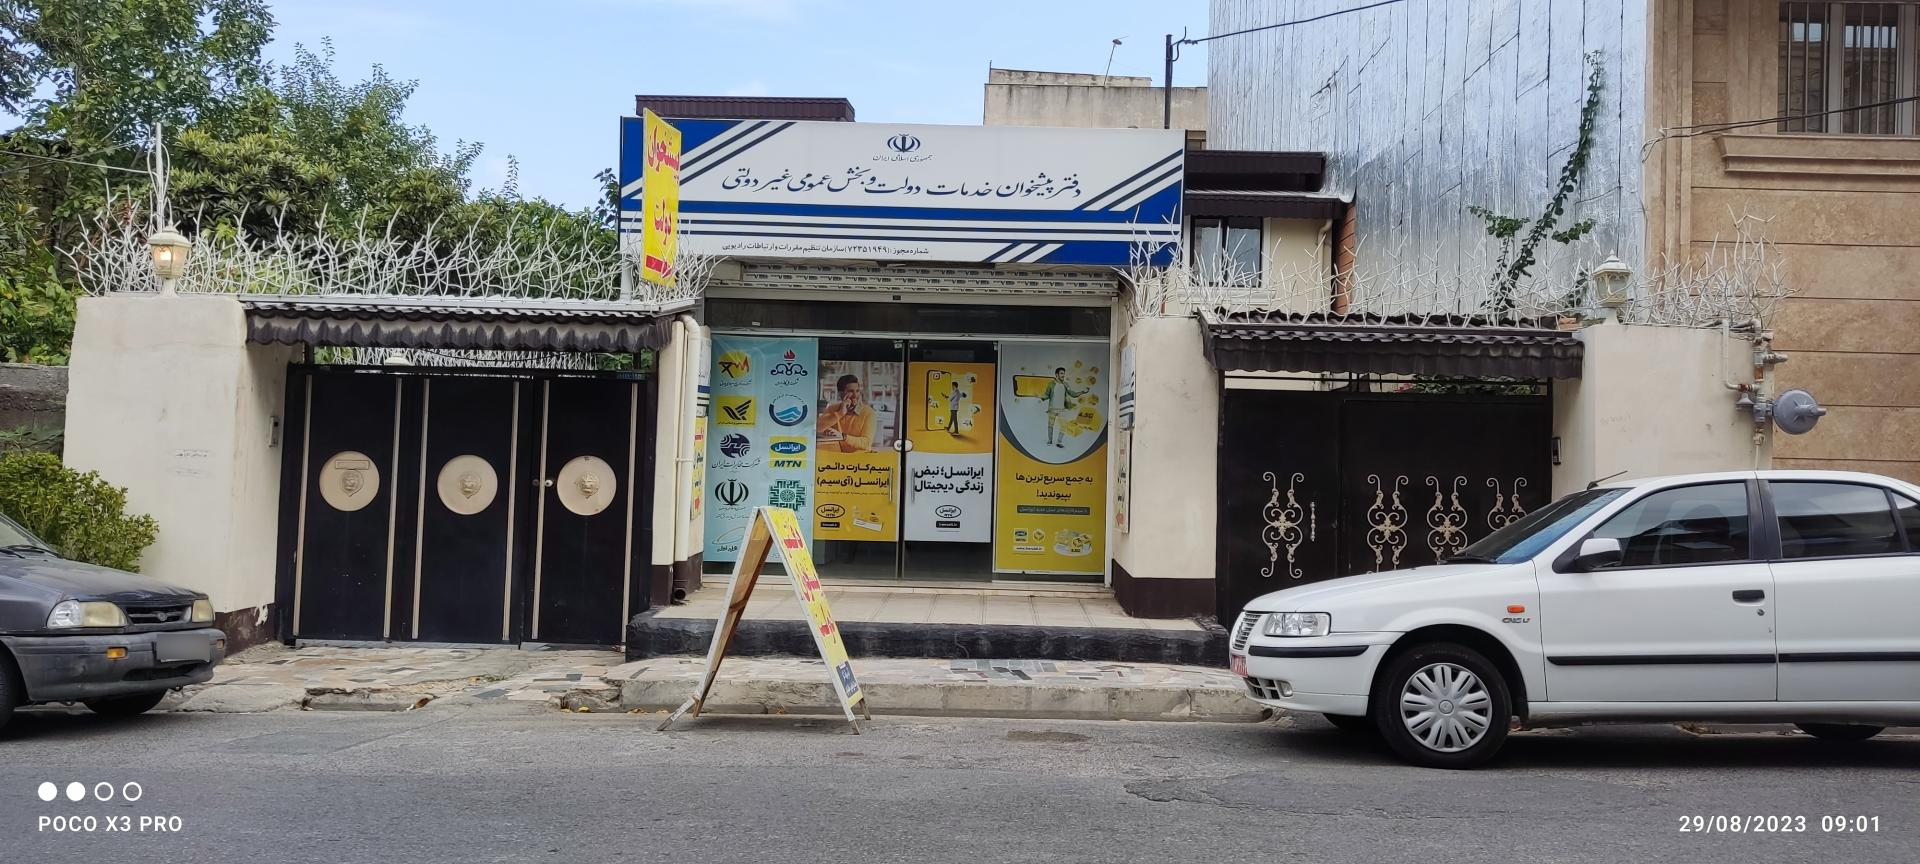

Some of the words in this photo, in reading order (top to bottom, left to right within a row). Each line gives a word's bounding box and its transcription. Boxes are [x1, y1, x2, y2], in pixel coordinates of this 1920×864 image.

[647, 125, 681, 183] پیشخوان
[722, 167, 759, 190] دولتی
[752, 168, 793, 193] غیر
[786, 172, 832, 192] عمومی
[827, 166, 872, 192] بخش
[867, 175, 877, 186] و
[996, 172, 1054, 198] پیشخوان
[864, 175, 921, 196] دولت
[926, 181, 992, 197] خدمات
[1045, 173, 1081, 200] دفتر
[653, 200, 672, 245] دولت
[721, 241, 747, 251] رادیویی
[778, 242, 803, 252] مقررات
[802, 243, 821, 254] تنظیم
[821, 244, 845, 253] سازمان
[909, 247, 929, 256] شماره
[774, 444, 801, 453] ایرانسل
[773, 459, 802, 468] MTN
[817, 462, 846, 473] دائمی
[914, 465, 940, 479] نبض
[854, 477, 890, 488] ایرانسل
[914, 480, 954, 493] دیجیتال
[955, 479, 984, 495] زندگی
[1065, 475, 1084, 486] جمع
[1084, 475, 1093, 486] به
